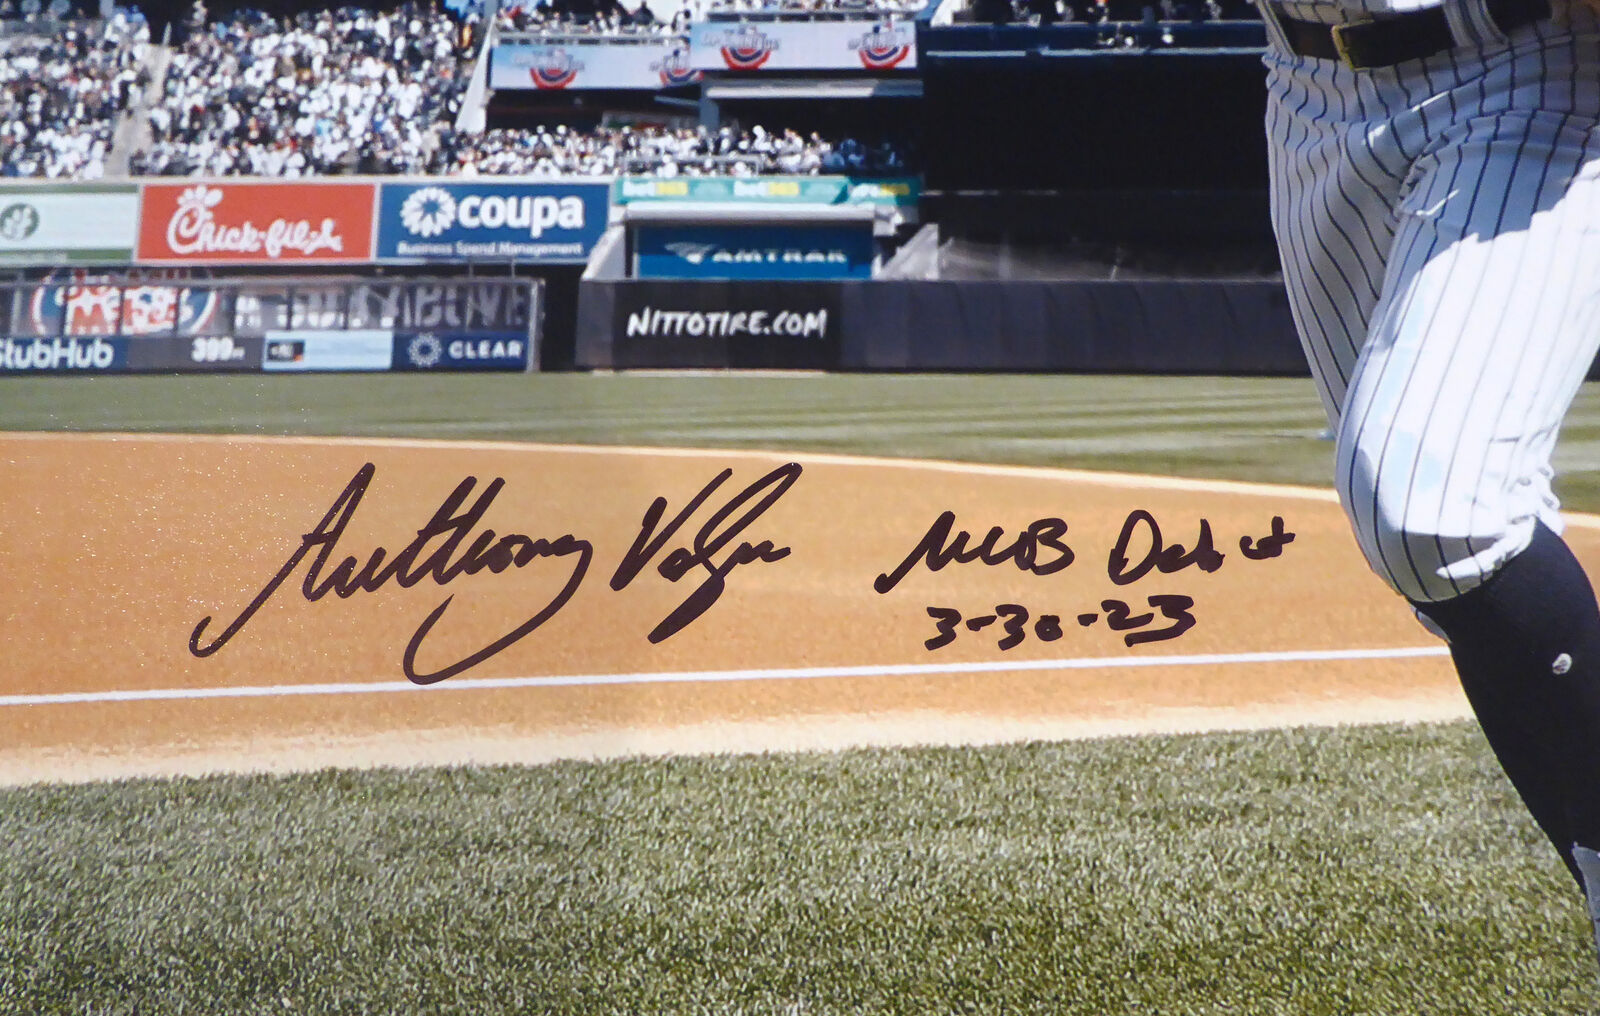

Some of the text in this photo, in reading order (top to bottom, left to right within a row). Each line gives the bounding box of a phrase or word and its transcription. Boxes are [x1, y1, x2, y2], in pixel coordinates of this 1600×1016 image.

[167, 186, 343, 258] Chick-fil-A
[457, 194, 585, 239] coupa
[626, 306, 828, 339] NITTOTIRE.COM
[449, 340, 524, 359] CLEAR
[925, 595, 1196, 651] 3-30-23
